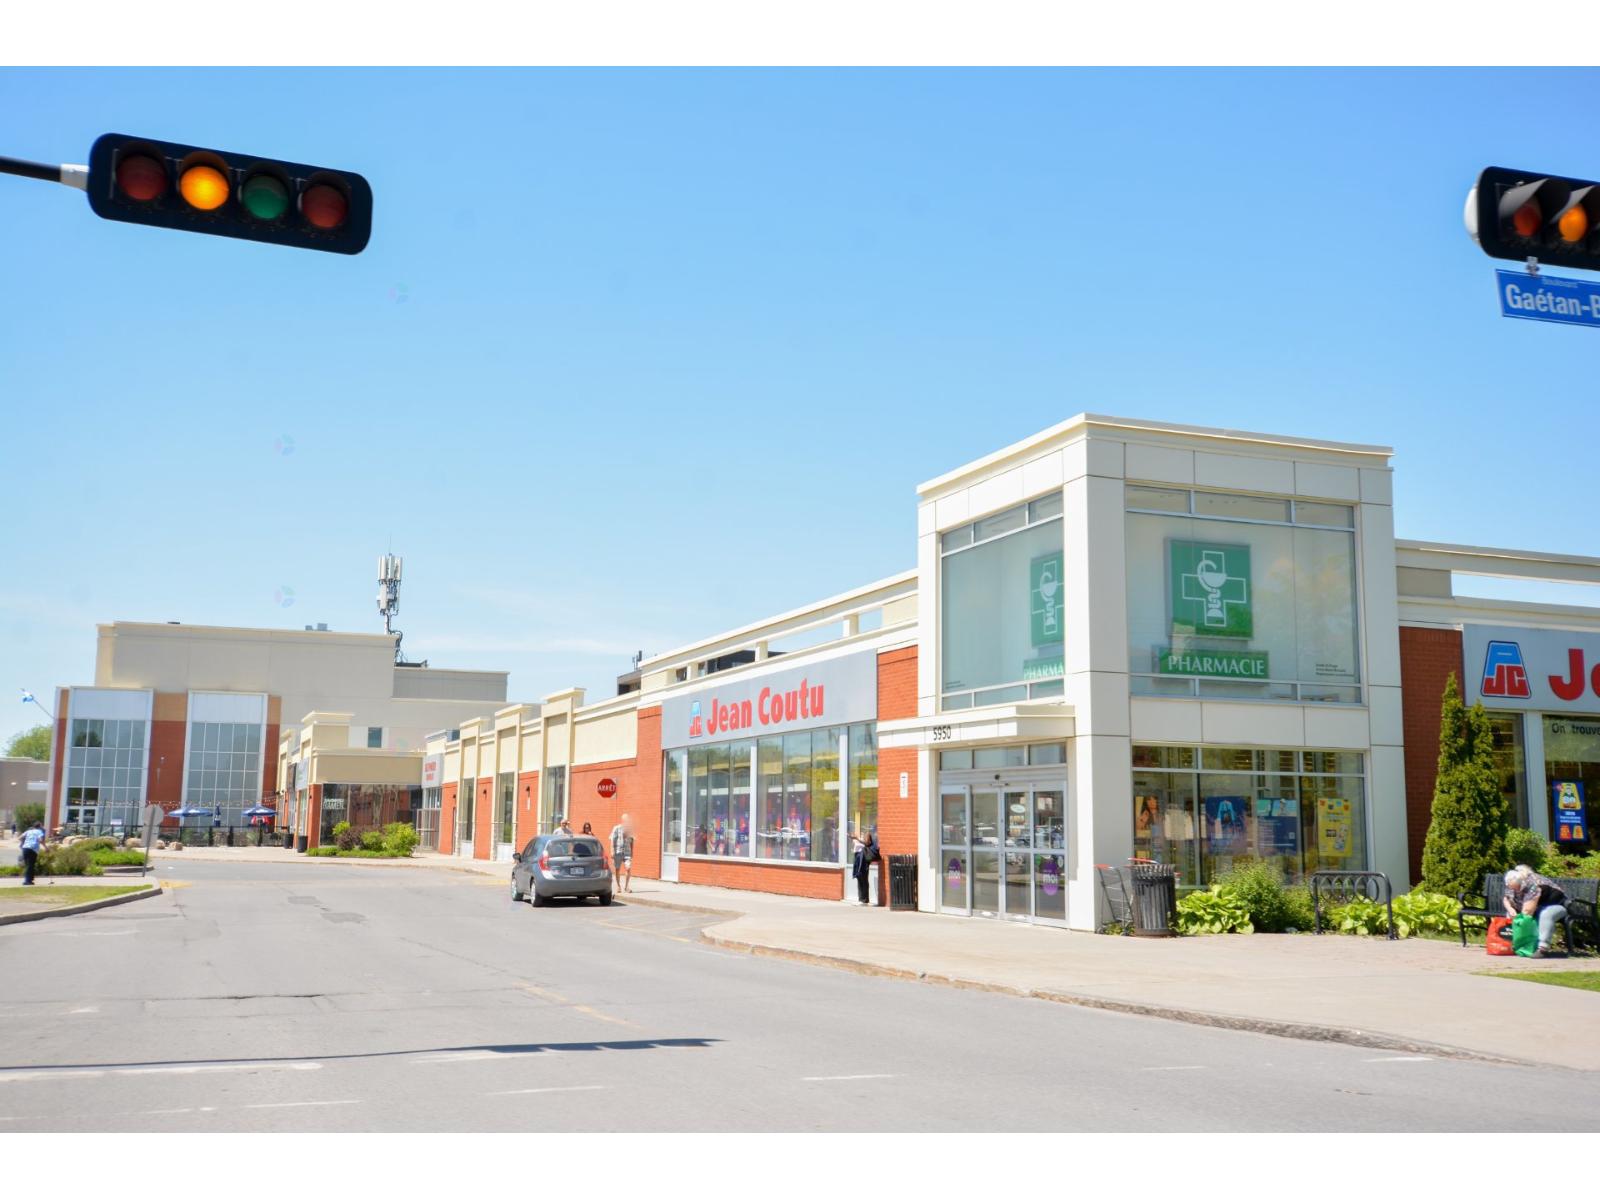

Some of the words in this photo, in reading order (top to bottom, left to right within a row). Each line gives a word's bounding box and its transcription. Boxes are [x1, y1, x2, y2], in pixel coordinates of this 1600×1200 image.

[1168, 655, 1265, 676] PHARMACIE
[1548, 648, 1600, 701] J
[706, 698, 752, 735] Jean
[758, 678, 824, 725] Coutu
[933, 725, 951, 741] 5950
[1551, 723, 1566, 734] On
